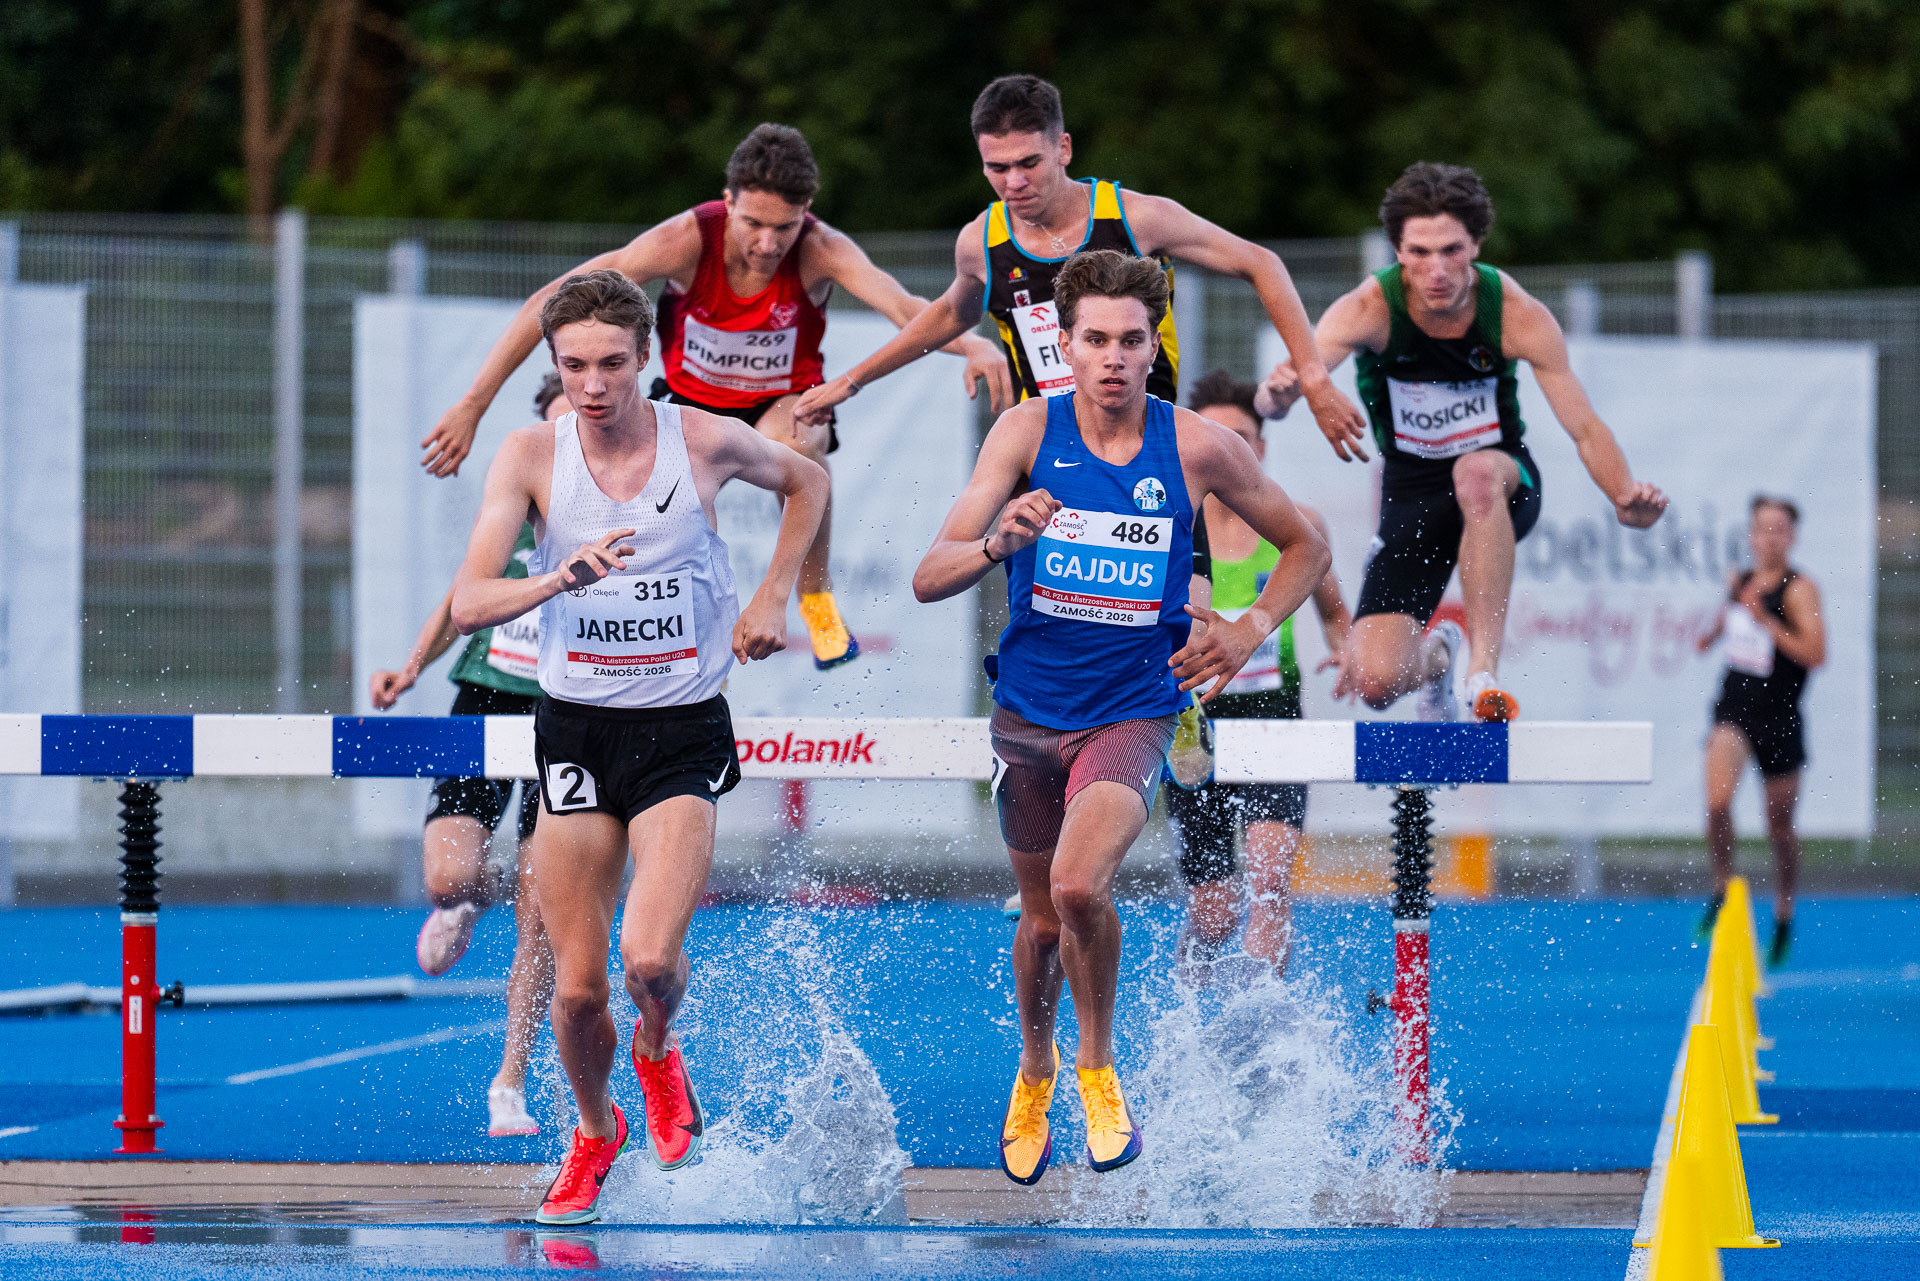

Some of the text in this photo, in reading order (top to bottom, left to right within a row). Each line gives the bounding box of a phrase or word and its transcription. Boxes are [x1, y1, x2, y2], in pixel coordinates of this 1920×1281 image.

[1031, 322, 1058, 334] ORLEN
[746, 334, 786, 348] 269
[688, 340, 788, 371] PIMPICKI
[1038, 343, 1063, 367] FI
[1400, 395, 1486, 430] KOSICKI
[1059, 520, 1085, 531] ZAMOŚĆ
[1111, 521, 1160, 545] 486
[1045, 551, 1154, 588] GAJDUS
[592, 588, 620, 598] Okęcie
[634, 577, 680, 601] 315
[1041, 589, 1052, 598] 80.
[1052, 592, 1069, 602] PZLA
[1070, 594, 1114, 607] Mistrzostwa
[1137, 602, 1151, 610] U20
[1053, 604, 1134, 623] ZAMOŚĆ 2026
[576, 614, 684, 643] JARECKI
[578, 651, 686, 665] 80. PZLA Mistrzostwa Polski U20
[593, 665, 672, 677] ZAMOŚĆ 2026
[735, 731, 878, 764] polanik
[559, 765, 587, 806] 2
